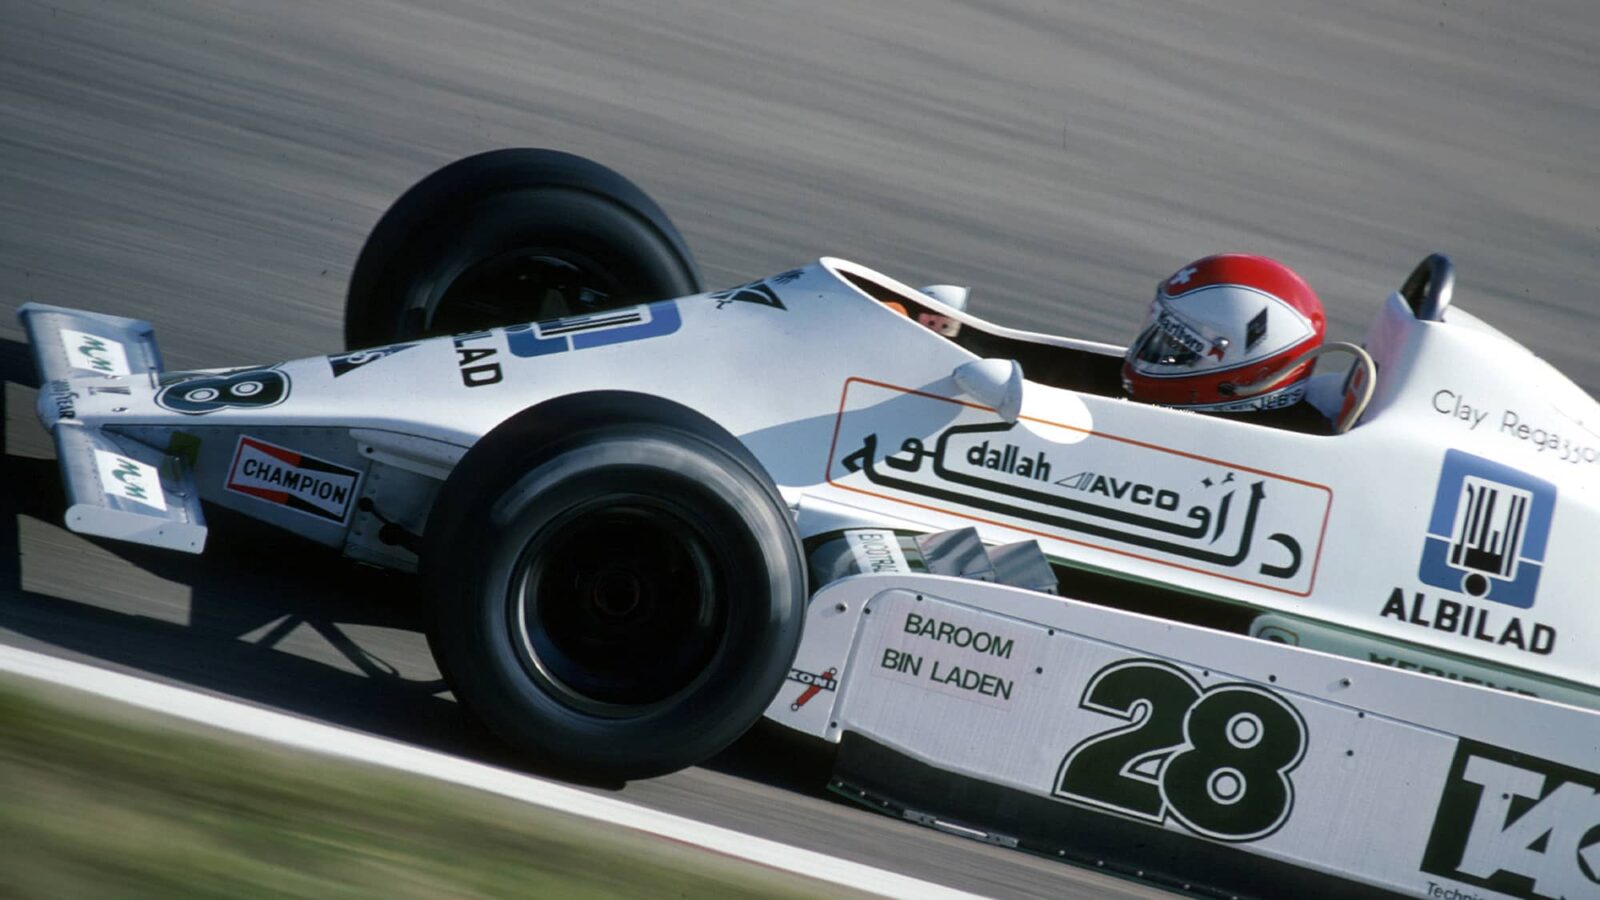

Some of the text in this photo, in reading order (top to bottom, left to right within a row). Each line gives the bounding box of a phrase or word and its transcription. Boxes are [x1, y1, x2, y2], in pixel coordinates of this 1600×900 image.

[1432, 389, 1600, 464] Clay Regazzo
[243, 458, 348, 505] CHAMPION
[967, 440, 1051, 484] dallah
[1089, 475, 1181, 512] AVCO
[904, 612, 1015, 660] BAROOM
[1379, 587, 1557, 656] ALBILAD
[787, 669, 838, 692] KONI
[881, 648, 1014, 701] BIN LADEN
[1051, 657, 1309, 844] 28
